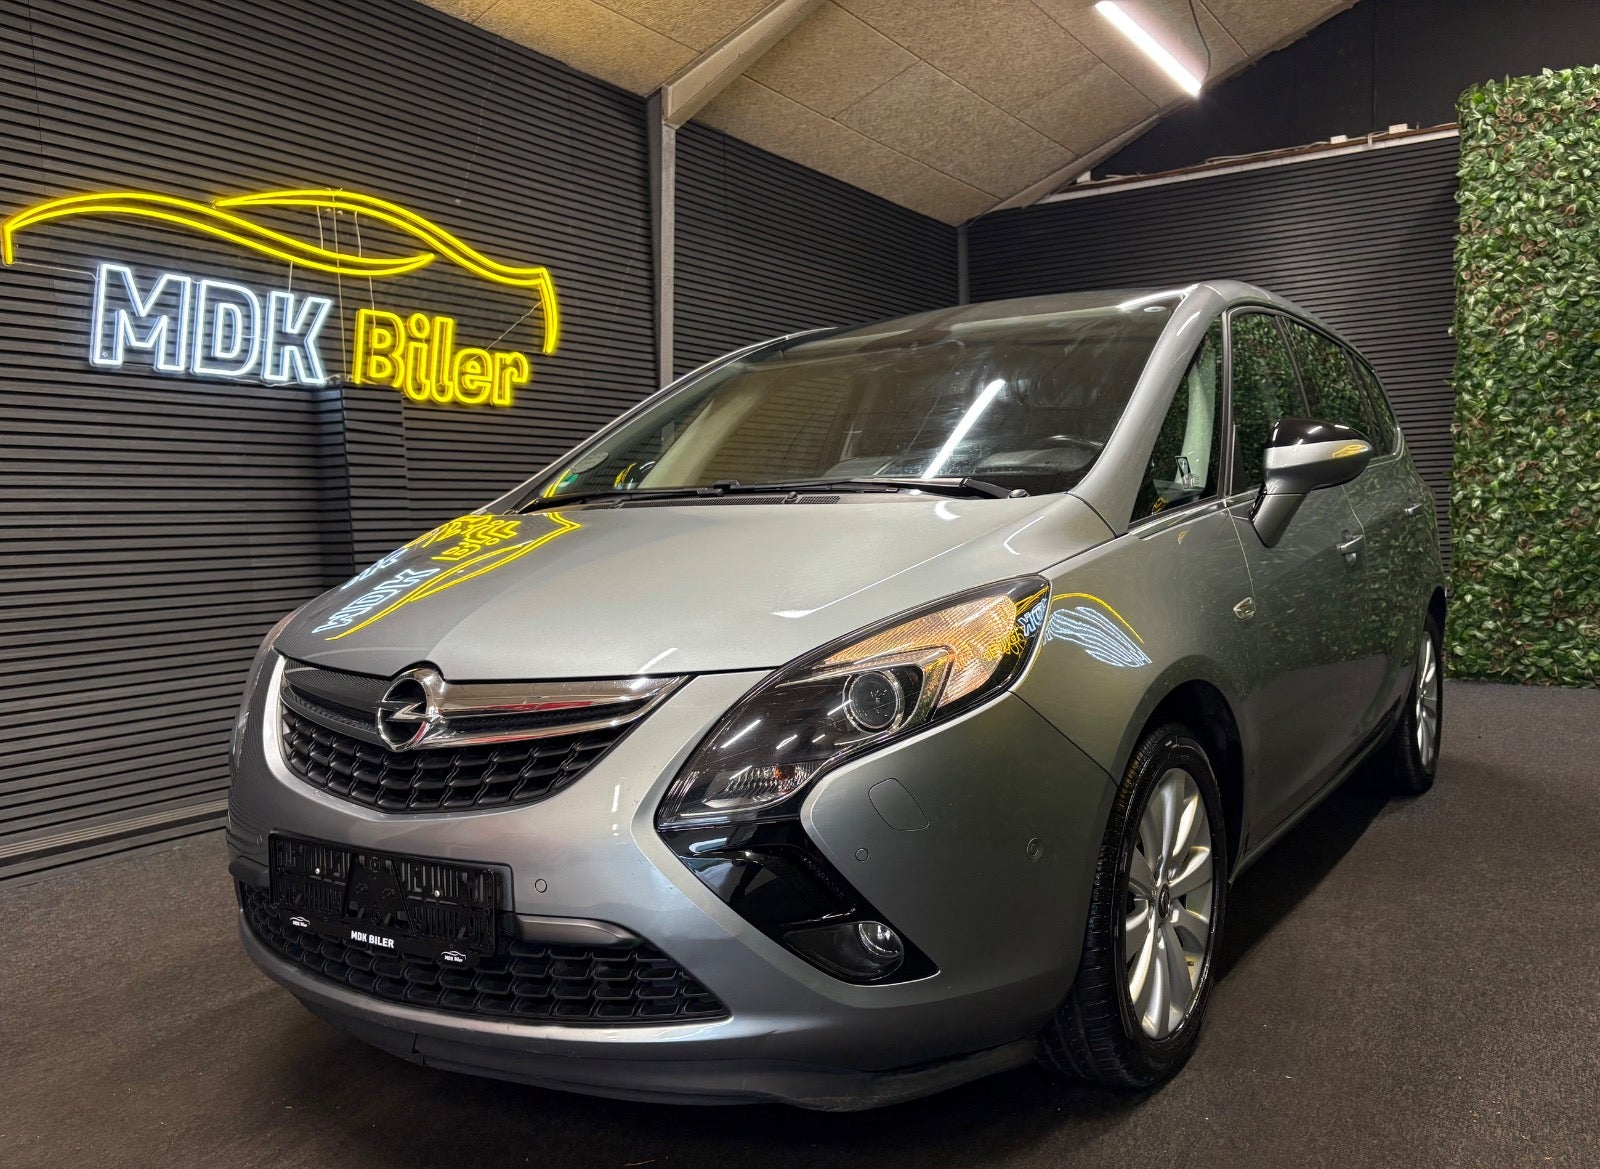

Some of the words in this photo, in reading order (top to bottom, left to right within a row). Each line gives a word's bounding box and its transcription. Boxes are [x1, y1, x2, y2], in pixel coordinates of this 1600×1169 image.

[91, 262, 332, 385] MDK
[352, 308, 531, 407] Biler
[350, 930, 368, 943] MDK
[368, 934, 395, 949] BILER
